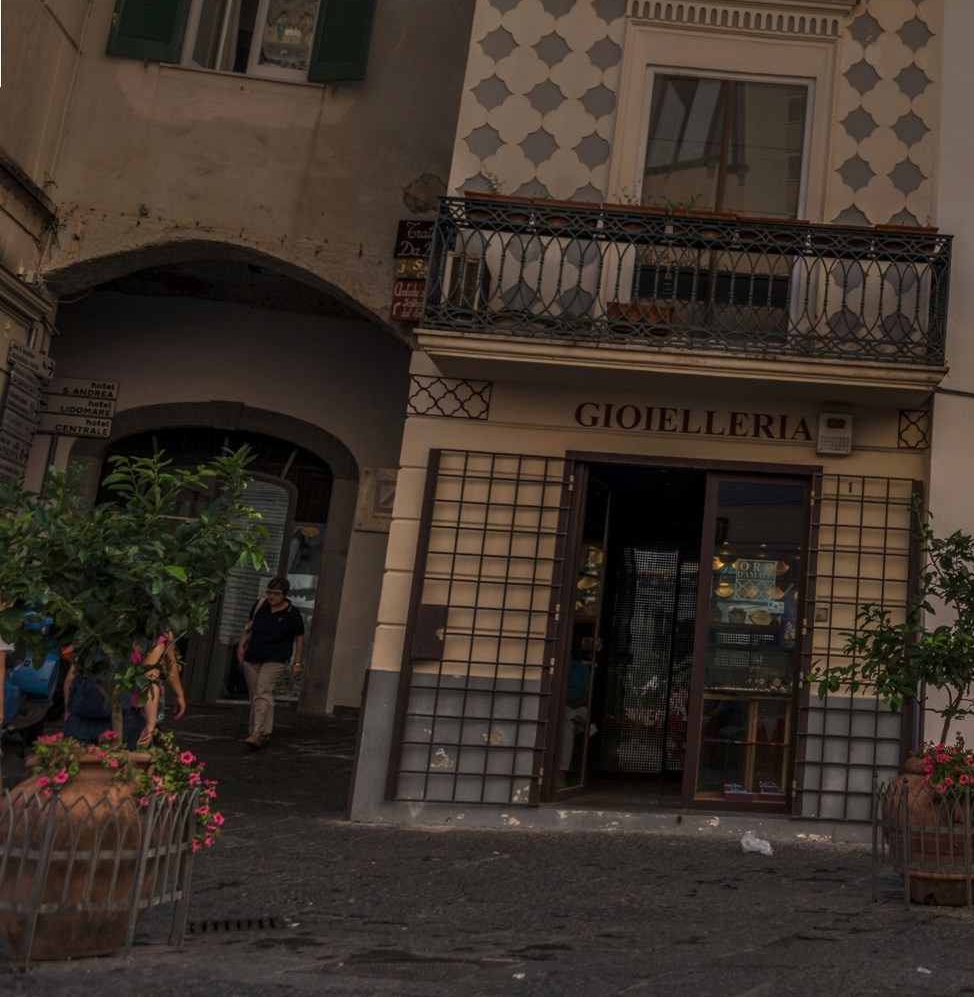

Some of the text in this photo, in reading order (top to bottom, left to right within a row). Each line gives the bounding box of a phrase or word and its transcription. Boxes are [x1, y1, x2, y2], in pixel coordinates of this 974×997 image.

[91, 381, 115, 391] hotel
[73, 388, 114, 398] ANDREA
[88, 400, 112, 409] hotel
[60, 405, 111, 417] LIDOMARE
[85, 418, 110, 428] hotel
[574, 402, 813, 441] GIOIELLERIA
[55, 424, 109, 436] CENTRALE
